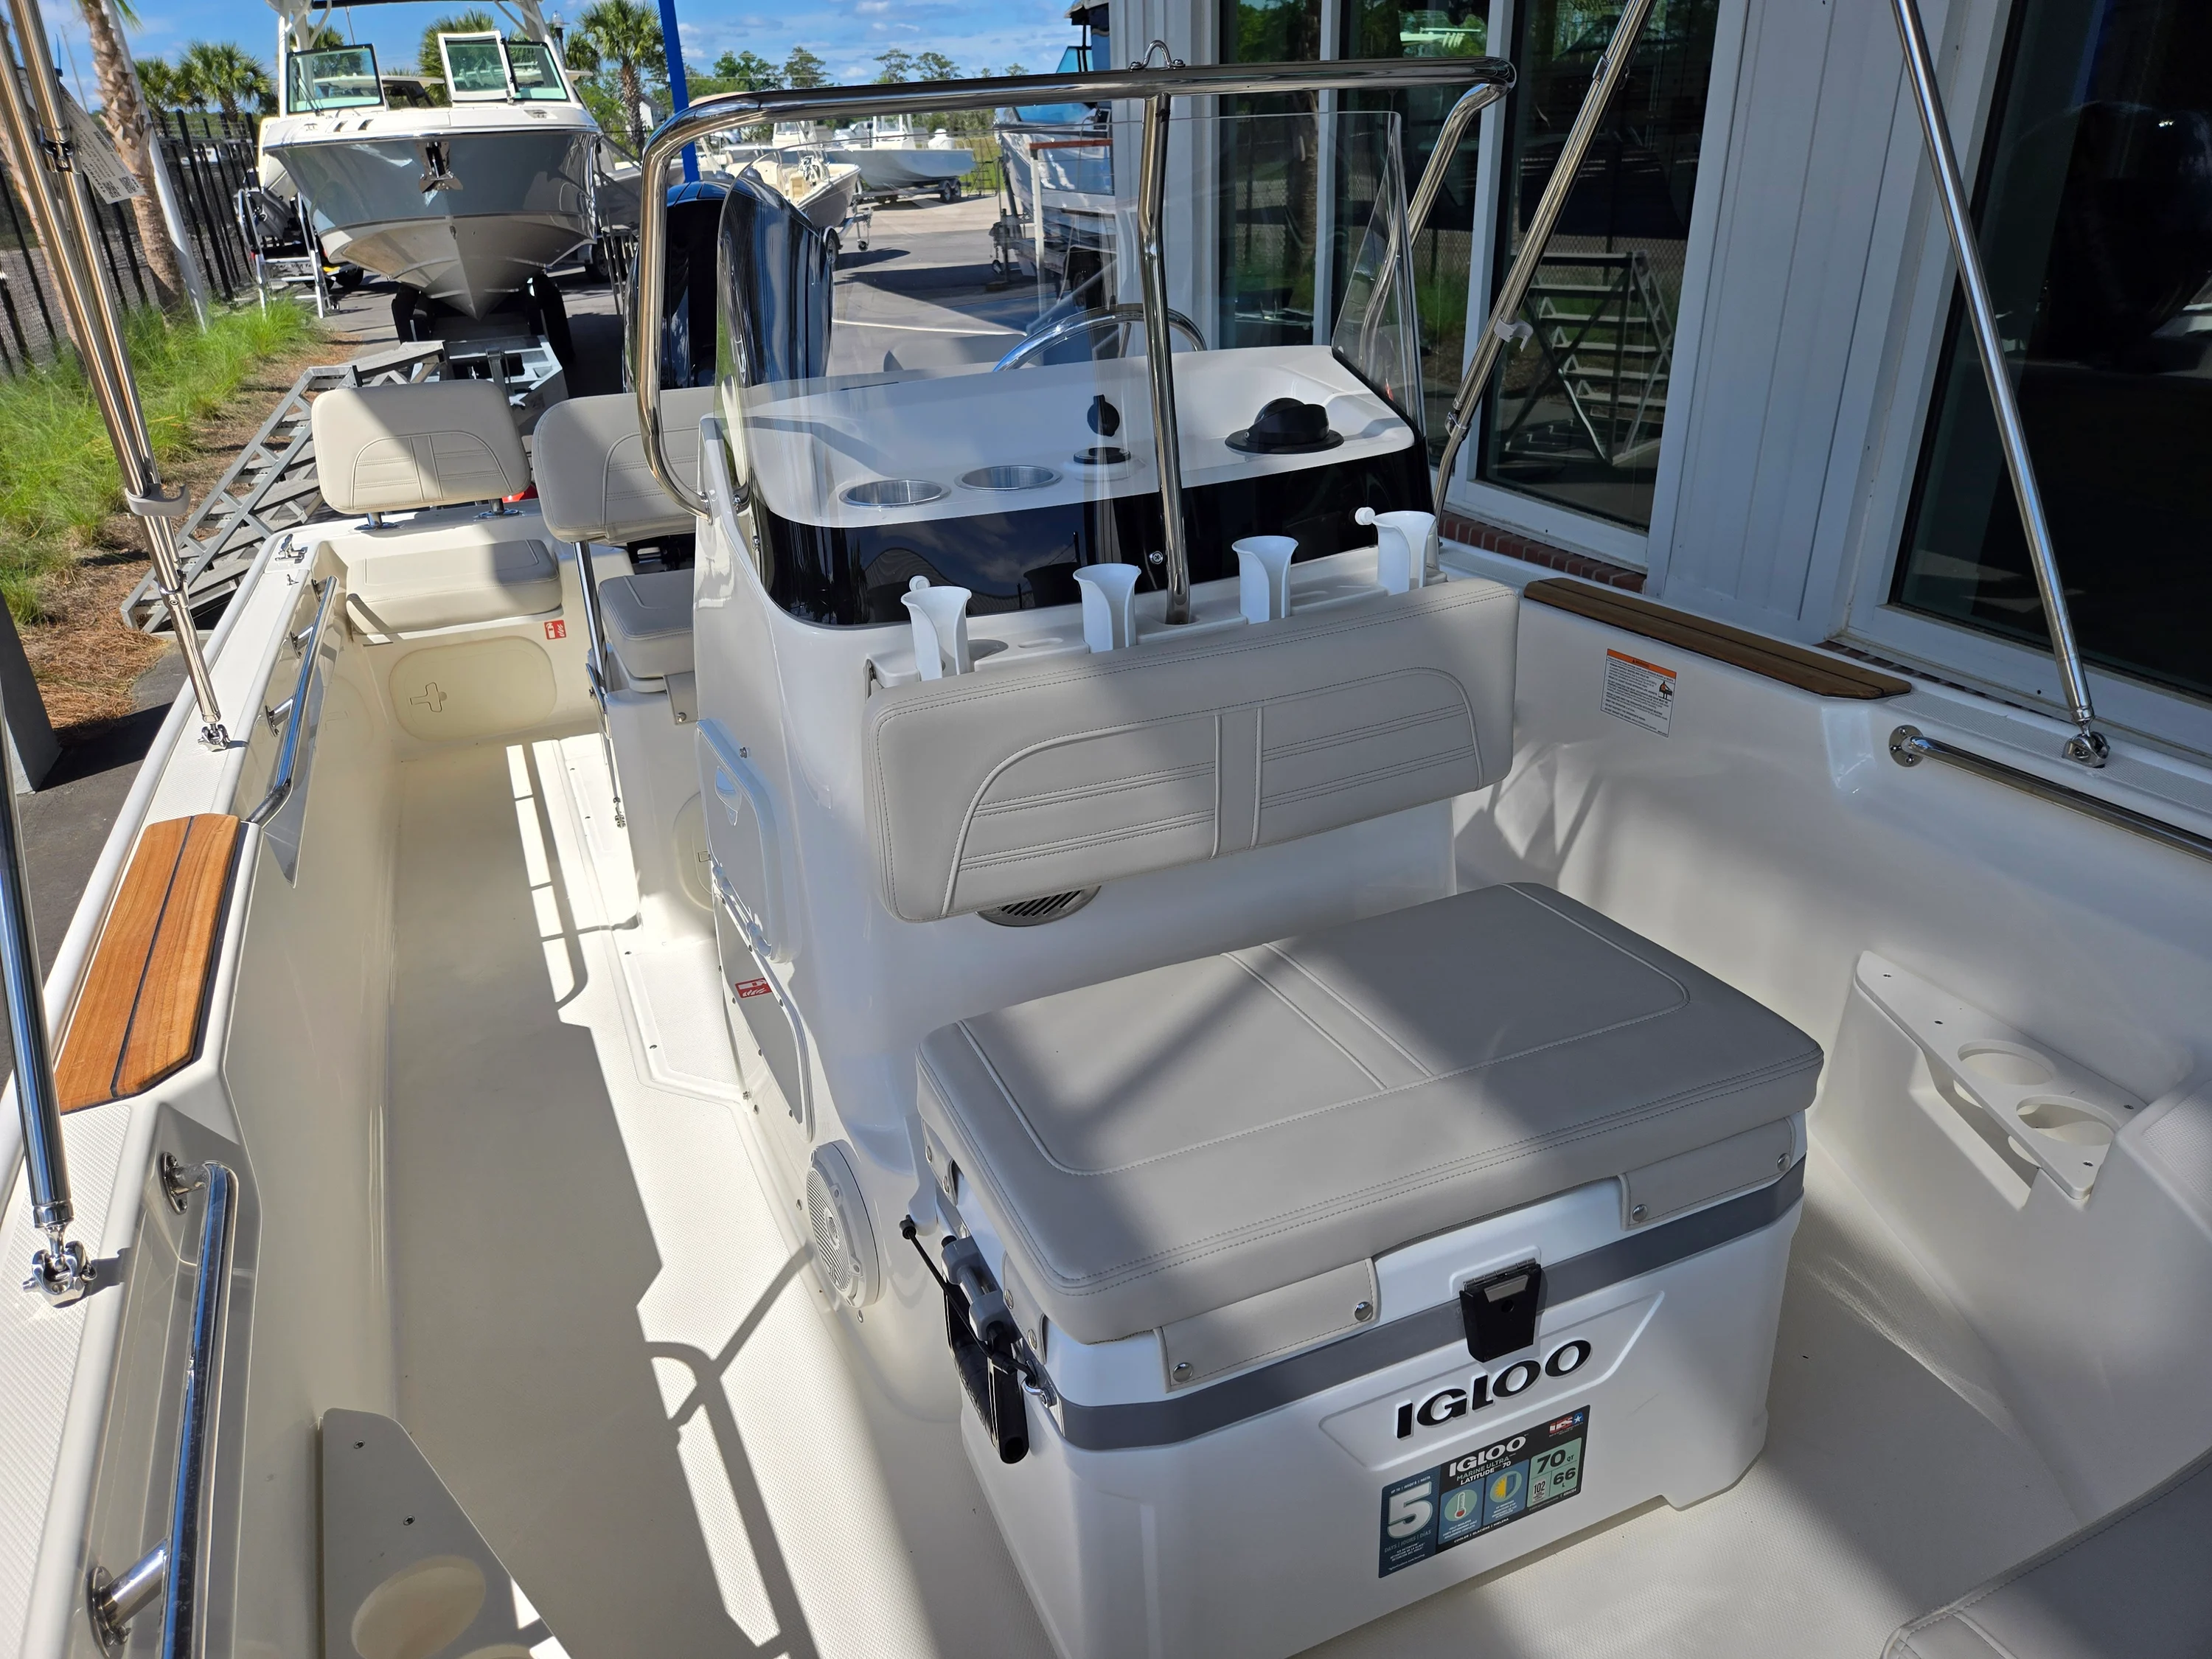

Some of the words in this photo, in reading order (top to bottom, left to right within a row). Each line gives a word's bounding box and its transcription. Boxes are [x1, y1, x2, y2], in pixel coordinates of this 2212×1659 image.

[1397, 1340, 1592, 1439] IGLOO
[1450, 1436, 1526, 1477] IGLOO
[1456, 1465, 1485, 1481] MARINE
[1486, 1455, 1509, 1470] ULTRA
[1537, 1450, 1565, 1473] 70
[1567, 1454, 1574, 1462] QT
[1461, 1467, 1495, 1485] LATITUDE
[1502, 1460, 1511, 1468] 70
[1553, 1467, 1576, 1486] 66
[1534, 1481, 1545, 1494] 102
[1387, 1481, 1433, 1539] 5
